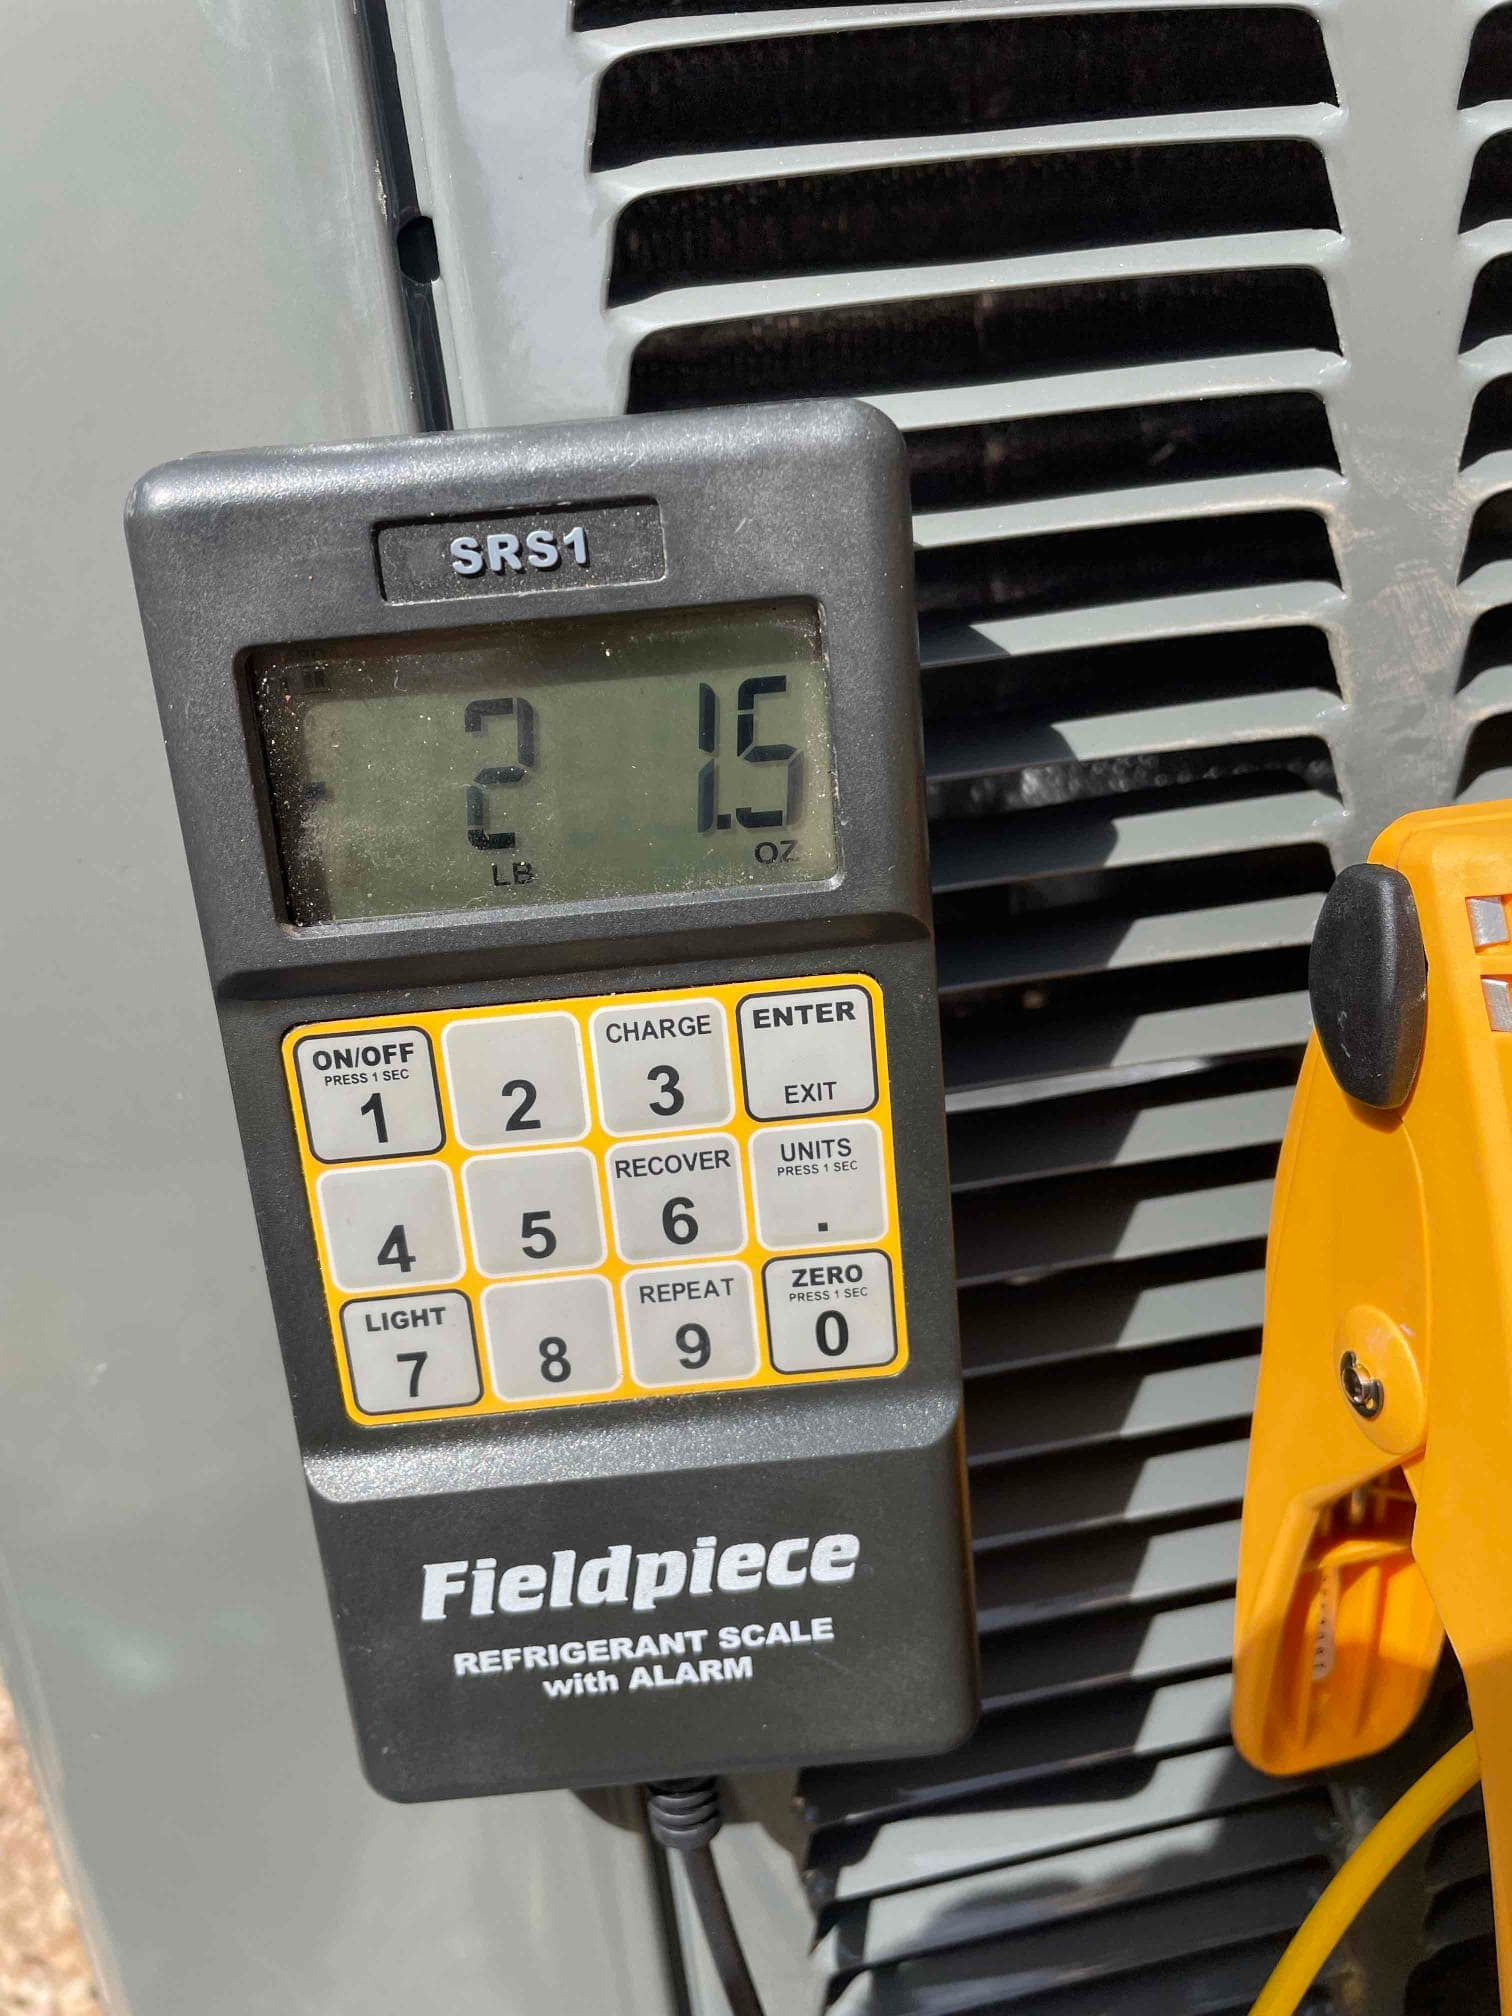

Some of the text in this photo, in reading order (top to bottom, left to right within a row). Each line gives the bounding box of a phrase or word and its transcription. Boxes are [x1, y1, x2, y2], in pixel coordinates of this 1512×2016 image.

[449, 526, 588, 574] SRS1
[463, 696, 536, 851] 2
[490, 839, 801, 888] LB OZ
[605, 1014, 712, 1044] CHARGE
[752, 1001, 856, 1029] ENTER
[312, 1042, 414, 1071] ON/OFF
[324, 1068, 409, 1086] PRESS 1 SEC
[501, 1079, 542, 1132] 2
[647, 1064, 685, 1117] 3
[784, 1081, 837, 1105] EXIT
[360, 1092, 389, 1144] 1
[614, 1149, 731, 1179] RECOVER
[777, 1160, 858, 1177] PRESS 1 SEC
[780, 1138, 852, 1162] UNITS
[521, 1210, 557, 1259] 5
[662, 1196, 699, 1246] 6
[377, 1224, 417, 1273] 4
[639, 1277, 734, 1304] REPEAT
[789, 1286, 869, 1303] PRESS 1 SEC
[791, 1264, 863, 1288] ZERO
[365, 1306, 446, 1332] LIGHT
[815, 1309, 849, 1357] 0
[539, 1336, 572, 1383] 8
[675, 1323, 711, 1370] 9
[396, 1351, 428, 1398] 7
[421, 1532, 861, 1621] Fieldpiece
[453, 1616, 835, 1676] REFRIGERANT SCALE
[541, 1655, 754, 1698] with ALARM
